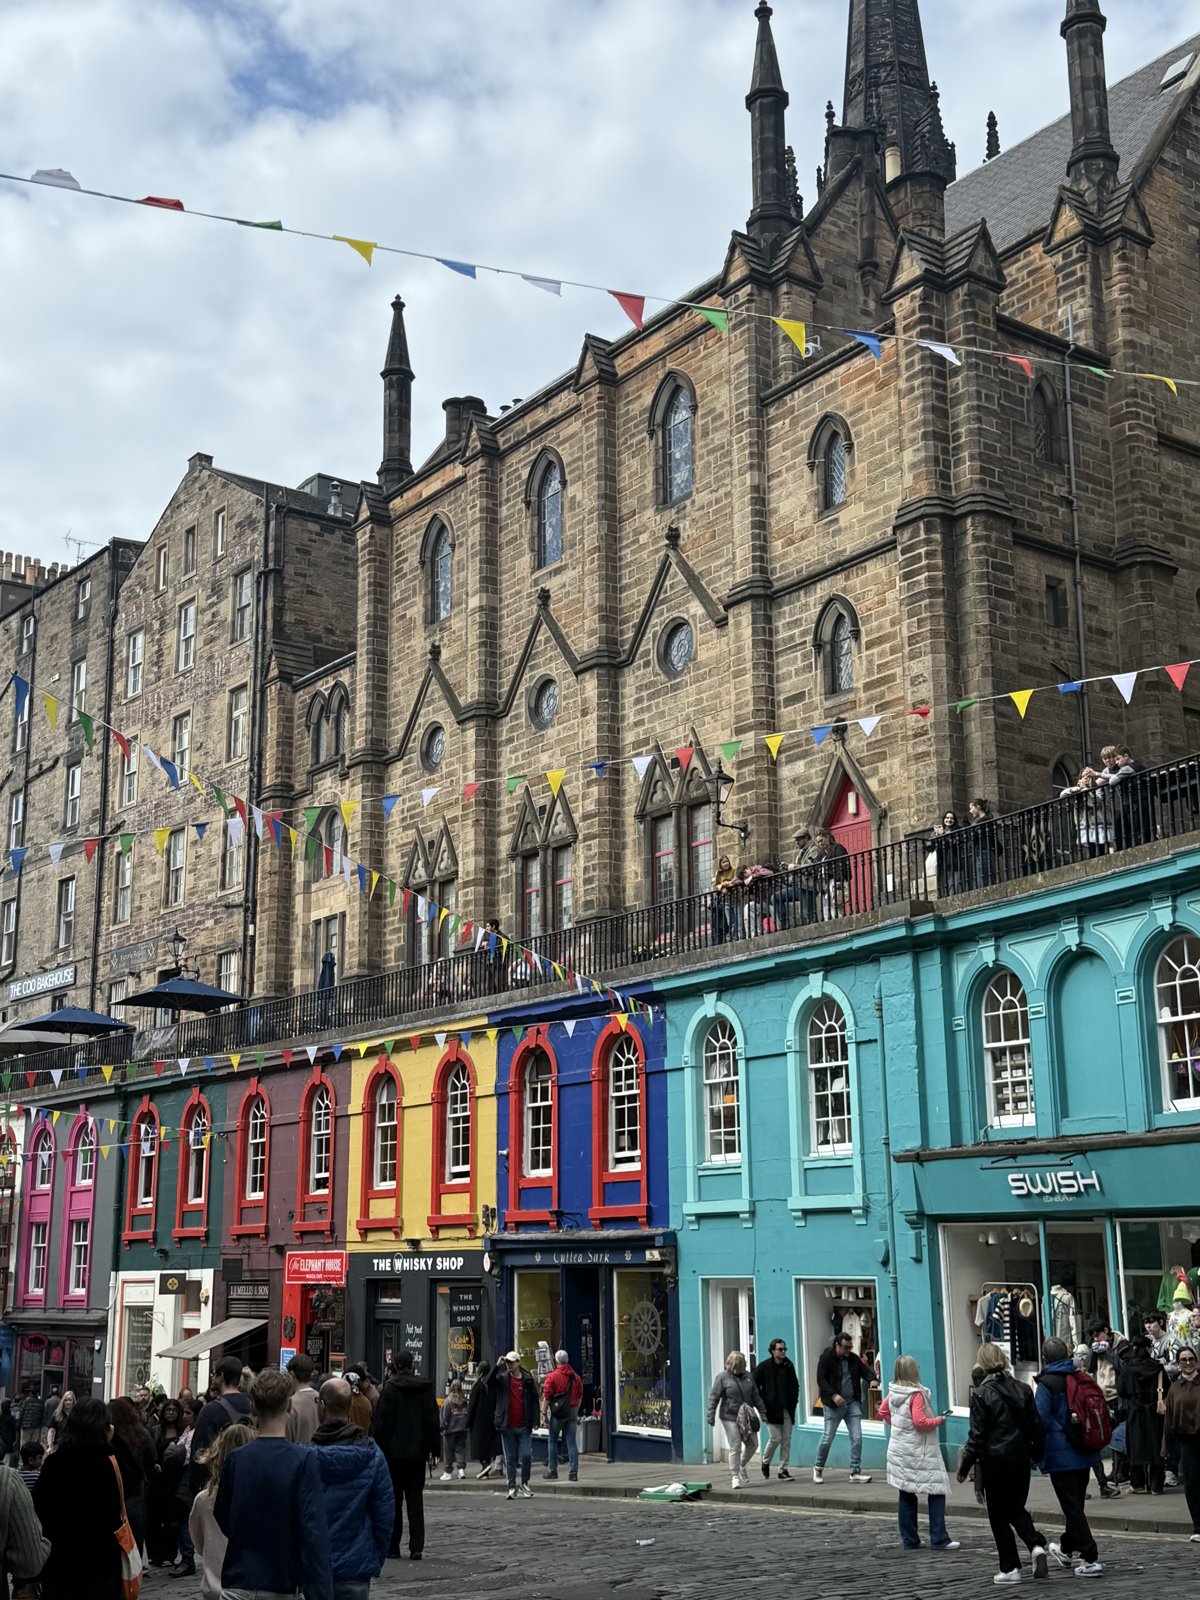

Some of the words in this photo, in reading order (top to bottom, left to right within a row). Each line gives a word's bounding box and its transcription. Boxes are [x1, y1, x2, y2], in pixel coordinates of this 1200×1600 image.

[10, 983, 22, 998] THE
[23, 979, 36, 995] COO
[36, 967, 74, 990] BAKEHOUSE
[1007, 1170, 1100, 1195] SWISH
[372, 1258, 392, 1271] THE
[394, 1257, 433, 1271] WHISKY
[436, 1256, 464, 1271] SHOP
[587, 1249, 610, 1264] Sark
[300, 1258, 325, 1272] ELEPHANT
[325, 1258, 342, 1272] HOUSE
[258, 1285, 269, 1296] SON
[452, 1304, 480, 1312] WHISKY
